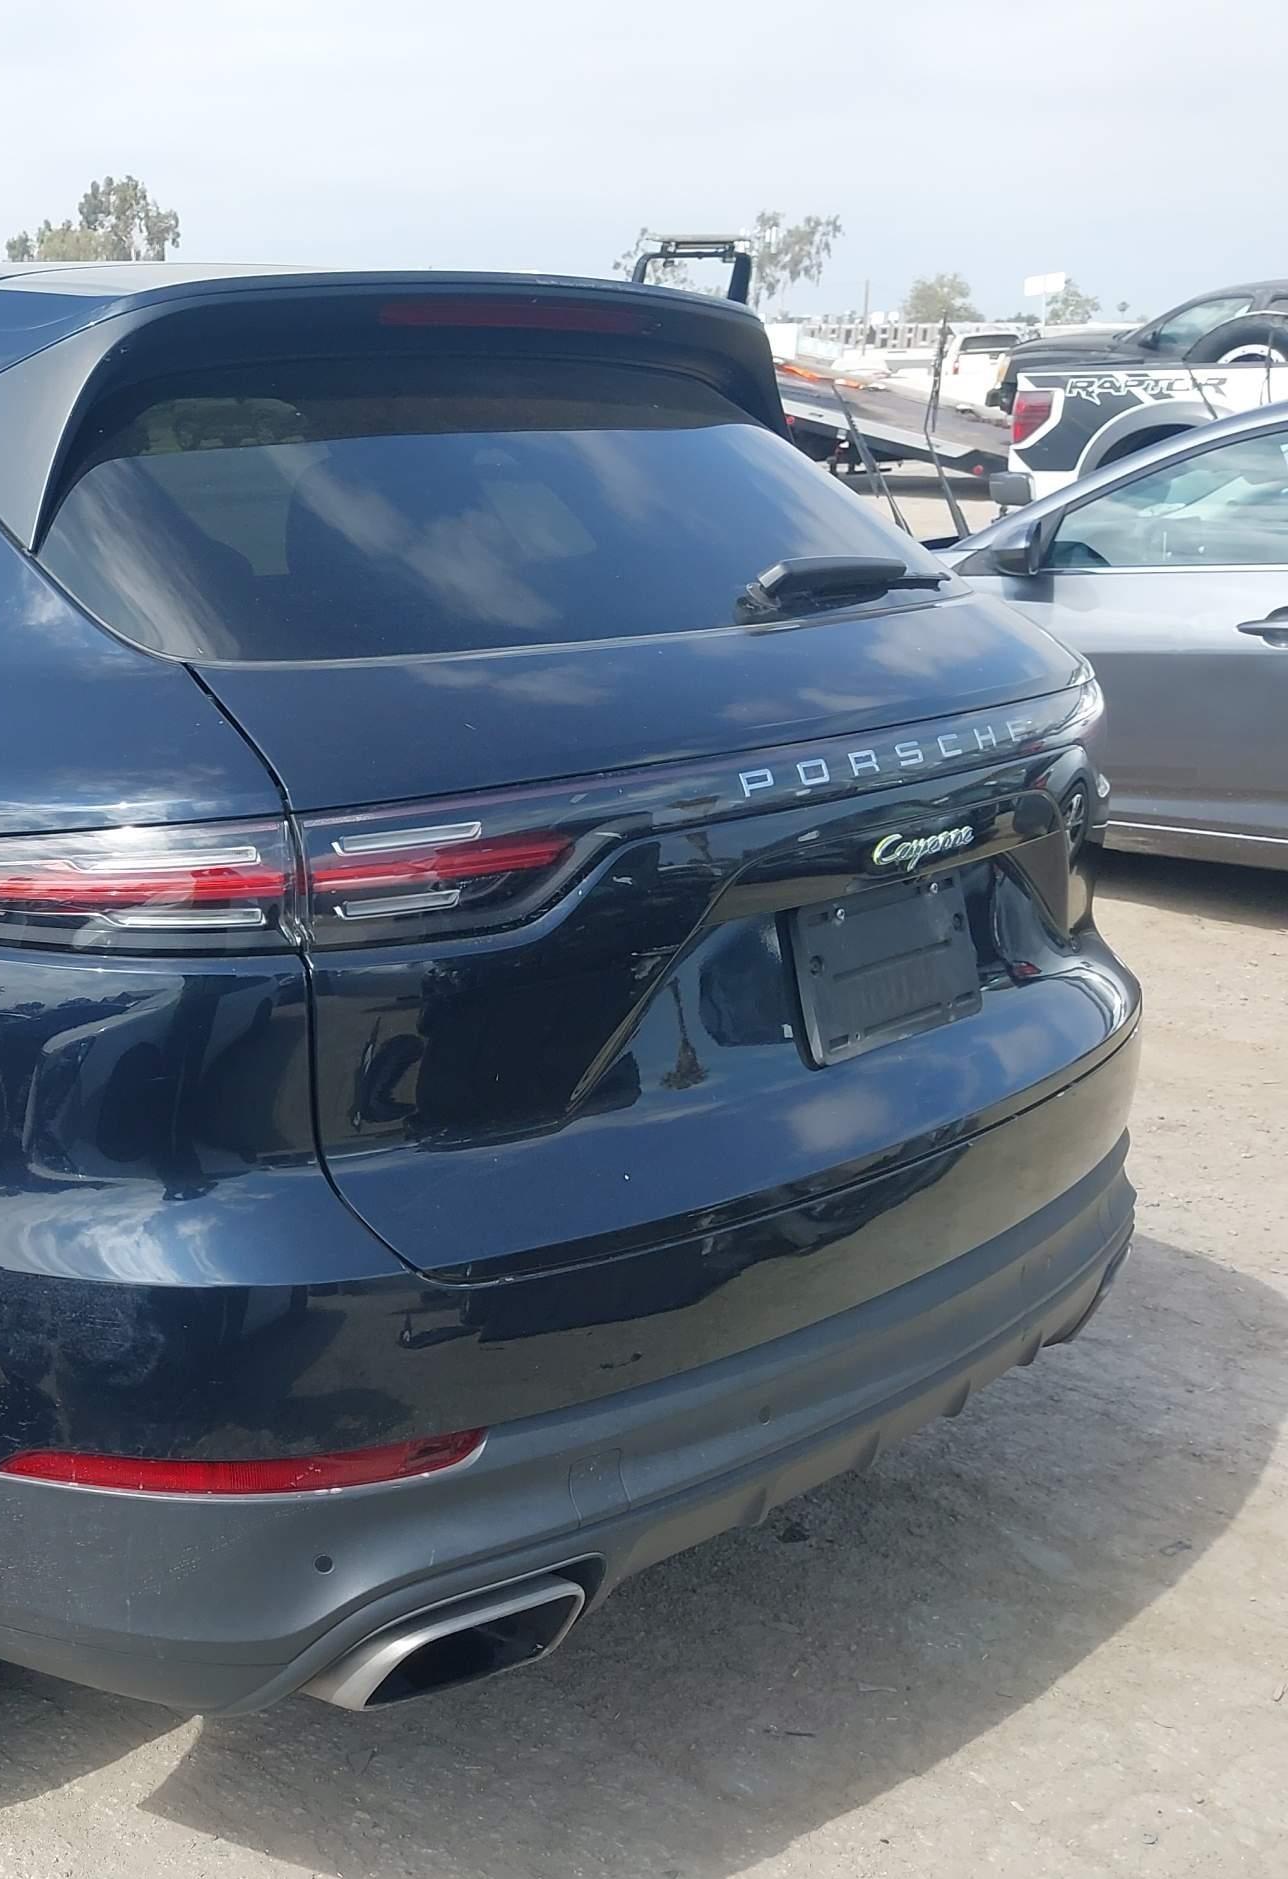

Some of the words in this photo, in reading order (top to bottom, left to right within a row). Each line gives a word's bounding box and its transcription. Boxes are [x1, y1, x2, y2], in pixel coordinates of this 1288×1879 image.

[1065, 377, 1228, 405] RAPTOR
[738, 720, 1031, 798] PORSCHE
[872, 825, 975, 872] Cayenne
